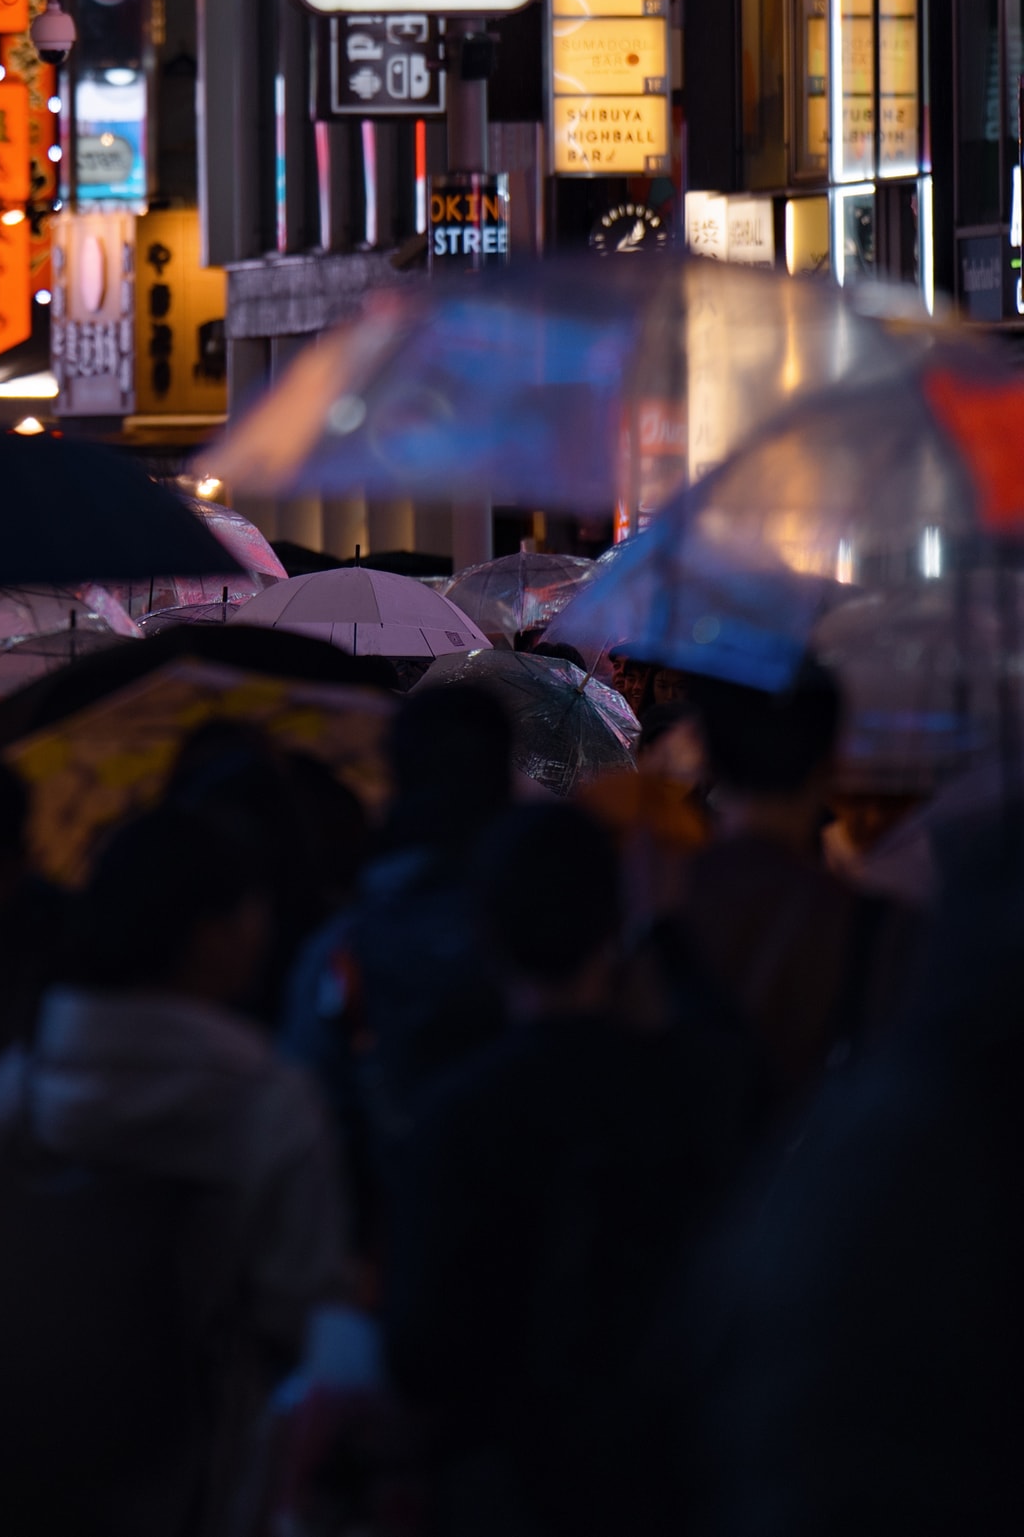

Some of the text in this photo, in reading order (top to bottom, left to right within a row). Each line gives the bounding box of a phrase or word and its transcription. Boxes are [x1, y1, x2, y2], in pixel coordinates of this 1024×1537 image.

[566, 109, 643, 123] SHIBUYA
[566, 130, 656, 144] HIGHBALL
[567, 150, 601, 163] BAR
